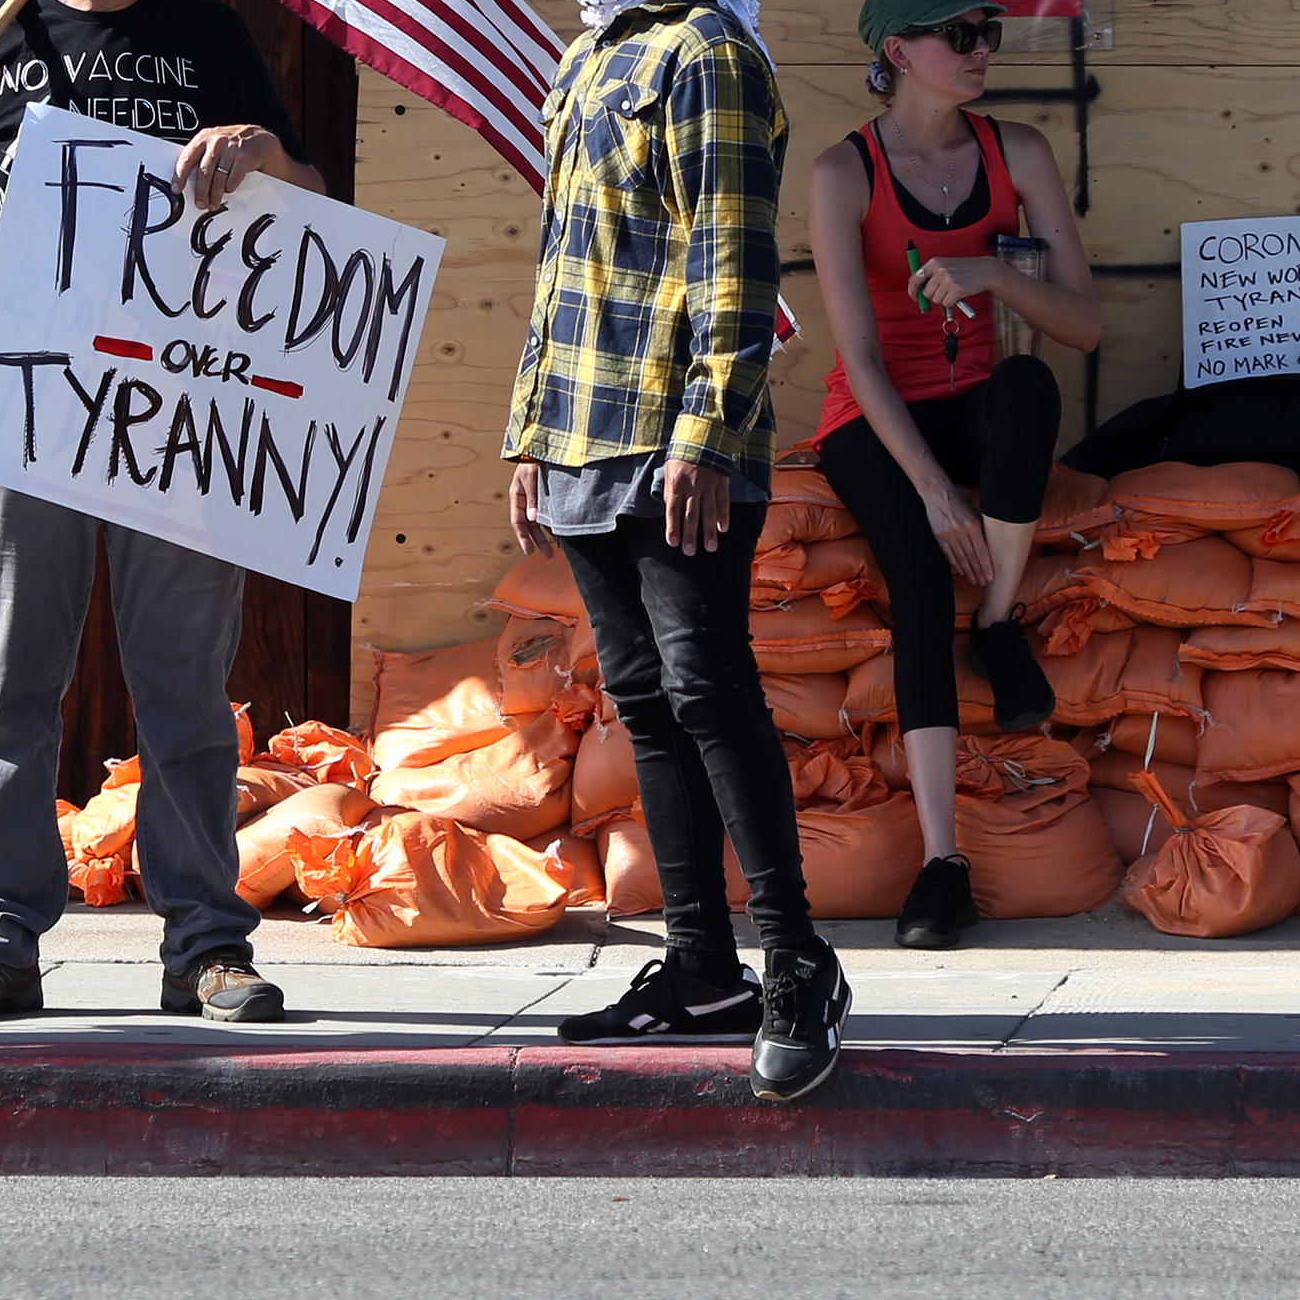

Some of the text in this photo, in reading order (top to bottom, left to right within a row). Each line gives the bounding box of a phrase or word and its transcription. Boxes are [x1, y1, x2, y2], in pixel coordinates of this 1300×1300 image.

[63, 50, 199, 89] VACCINE
[67, 98, 200, 132] NEEDED
[45, 137, 425, 404] FREEDOM
[1200, 270, 1256, 290] NEW
[1198, 314, 1284, 336] REOPEN
[1201, 335, 1252, 354] FIRE
[159, 338, 251, 386] OVER
[1197, 358, 1226, 380] NO
[1234, 352, 1290, 374] MARK
